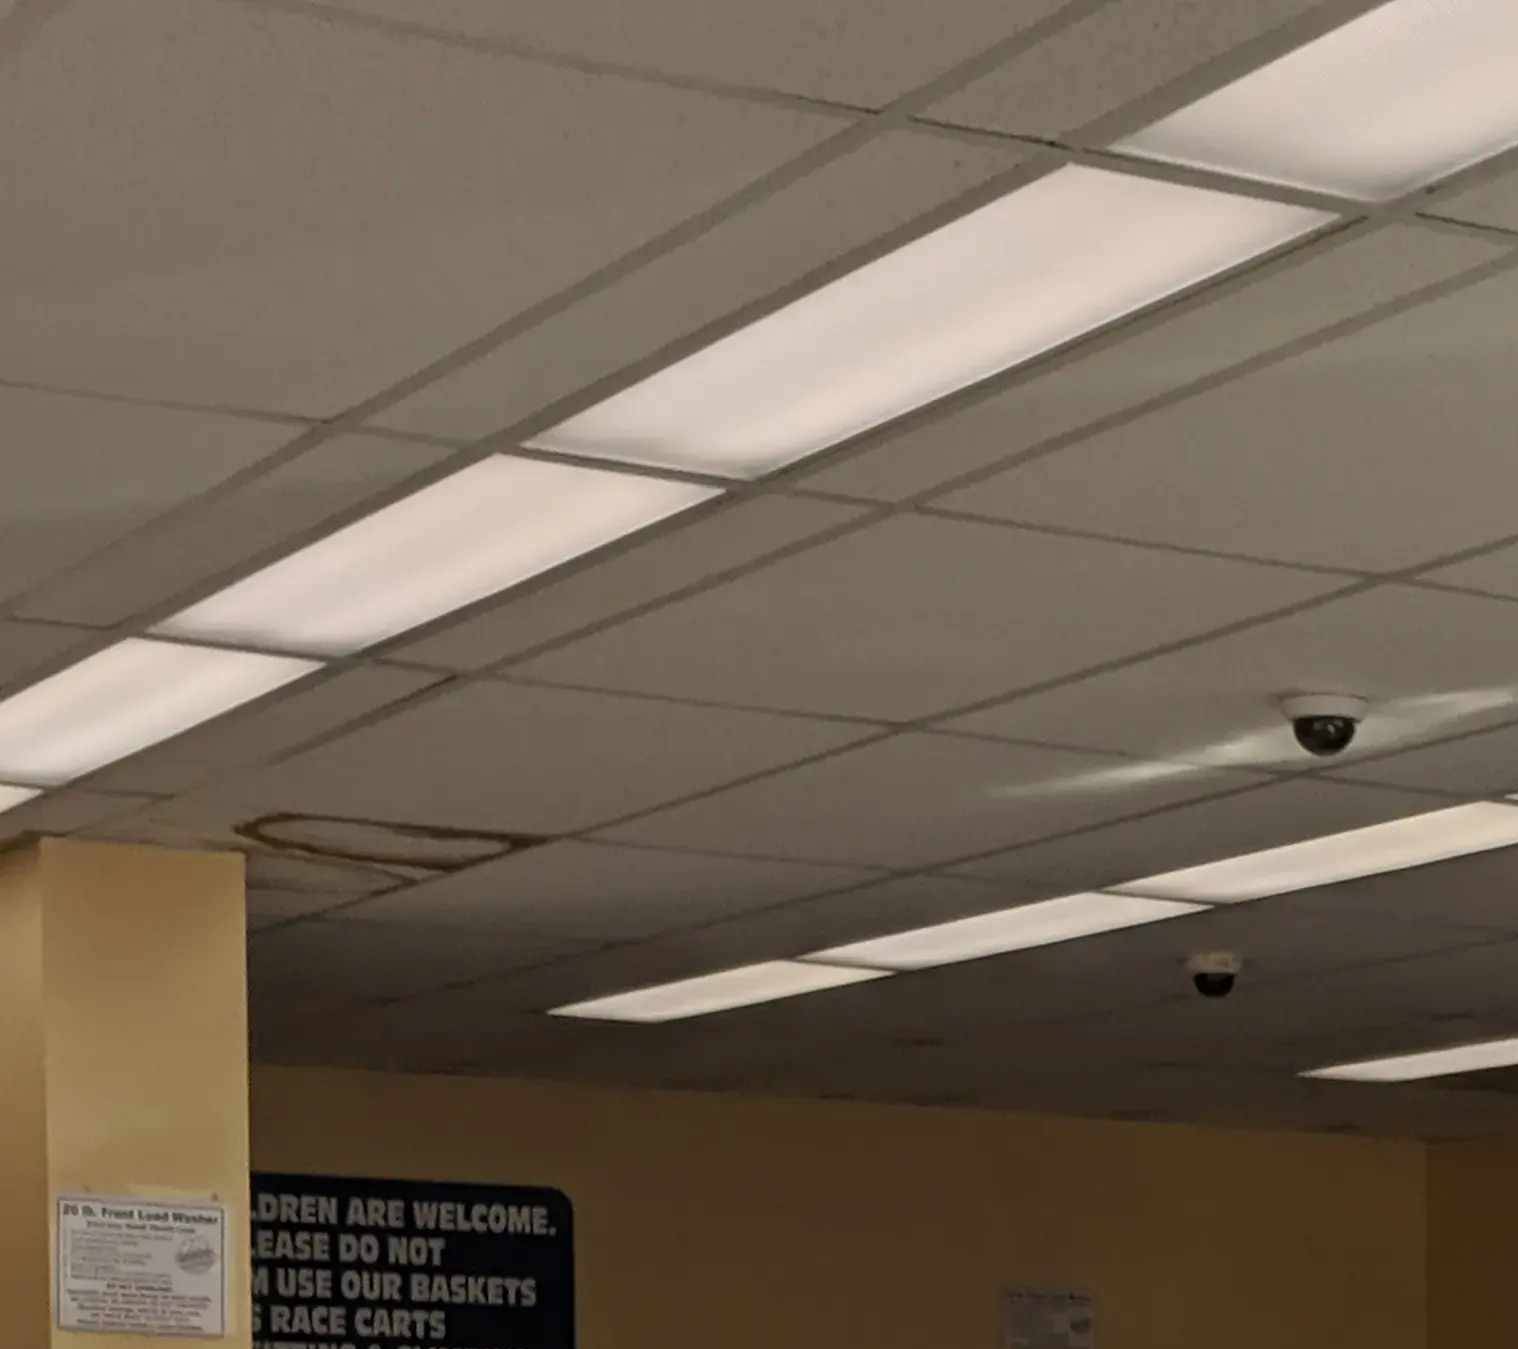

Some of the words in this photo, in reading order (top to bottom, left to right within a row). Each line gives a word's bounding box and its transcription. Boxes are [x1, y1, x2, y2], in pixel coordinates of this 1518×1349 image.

[138, 1209, 169, 1222] Load
[252, 1192, 338, 1225] DREN
[345, 1197, 405, 1229] ARE
[412, 1200, 557, 1237] WELCOME.
[252, 1229, 330, 1262] EASE
[338, 1234, 380, 1264] DO
[387, 1236, 447, 1266] NOT
[276, 1267, 333, 1299] USE
[340, 1270, 403, 1301] OUR
[409, 1273, 537, 1308] BASKETS
[270, 1304, 347, 1336] RACE
[354, 1308, 447, 1340] CARTS
